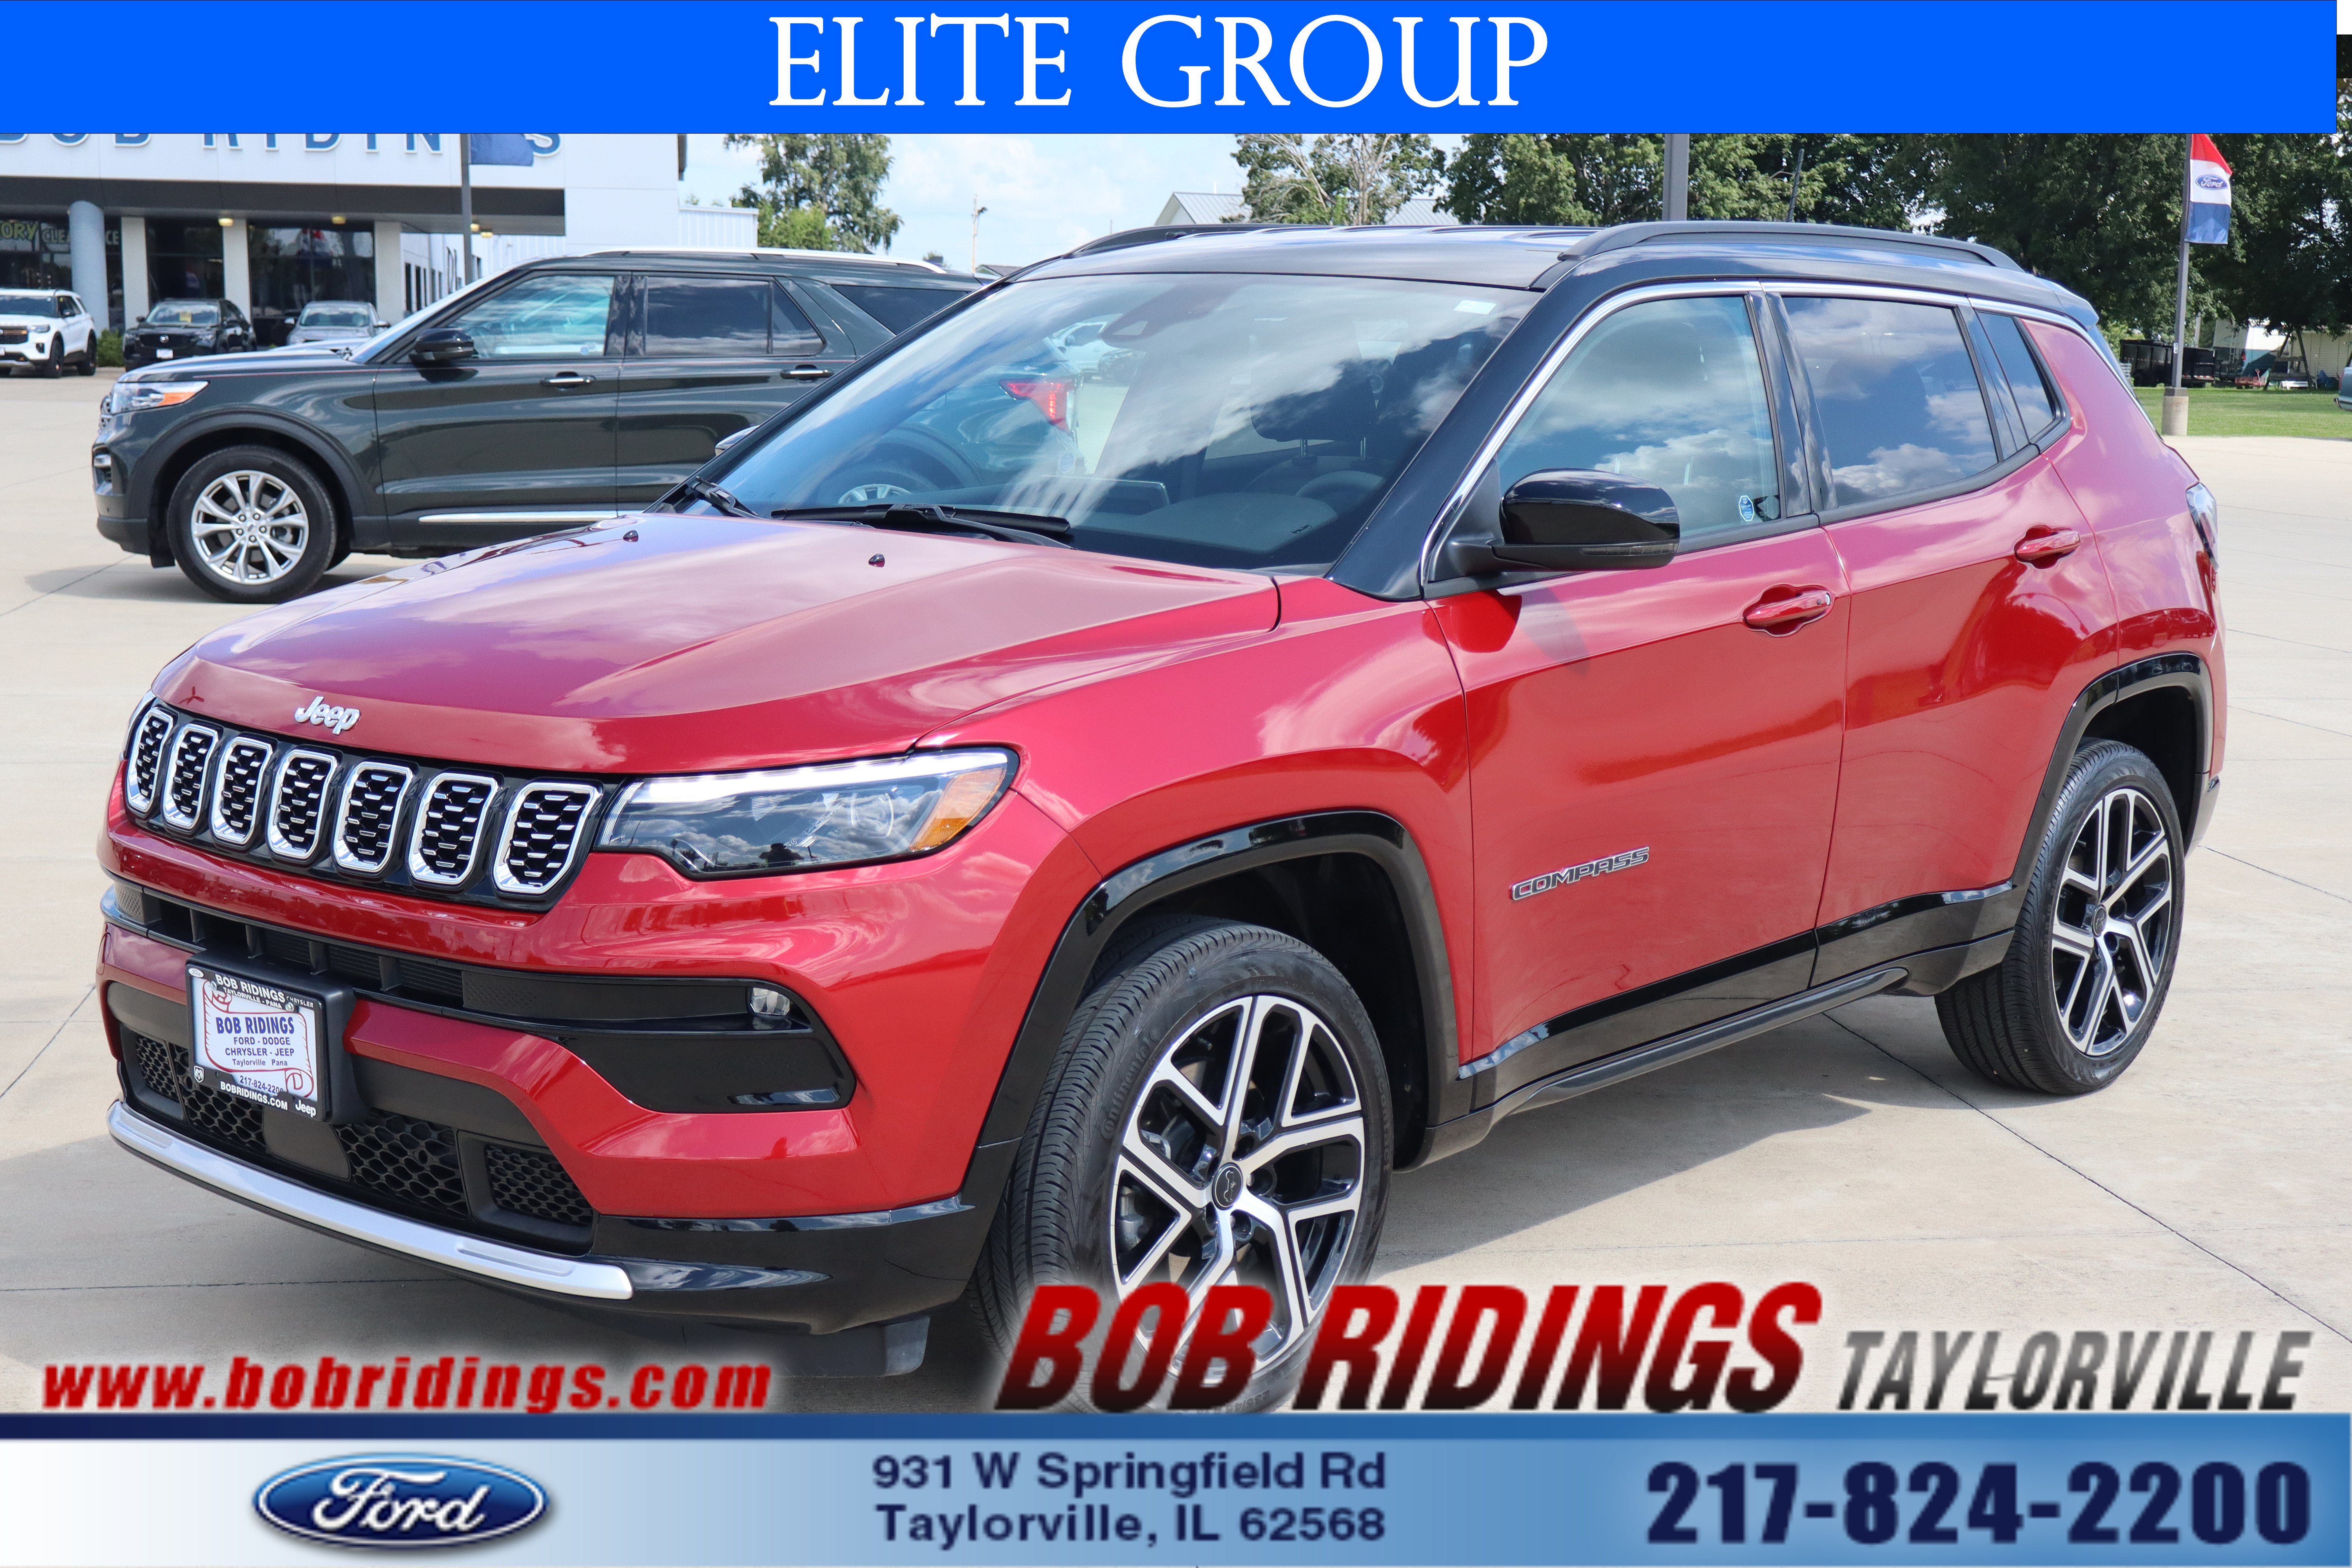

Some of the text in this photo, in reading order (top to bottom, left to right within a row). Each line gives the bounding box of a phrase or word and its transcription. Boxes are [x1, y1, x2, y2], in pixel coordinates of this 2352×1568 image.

[2201, 176, 2224, 188] Ford
[0, 222, 38, 240] ORY
[294, 696, 361, 735] Jeep
[1512, 846, 1650, 901] COMPASS
[215, 974, 285, 1003] BOB RIDINGS
[223, 987, 261, 1003] TAYLORVILLE
[265, 999, 282, 1009] PANA
[216, 1017, 294, 1034] BOB RIDINGS
[234, 1037, 256, 1045] FORD
[263, 1037, 291, 1045] DODGE
[225, 1048, 268, 1056] CHRYSLER
[274, 1048, 294, 1057] JEEP
[232, 1058, 266, 1067] Taylorville
[220, 1081, 288, 1111] BOBRIDINGS.COM
[1101, 1037, 1153, 1139] Continental
[295, 1100, 316, 1118] Jeep
